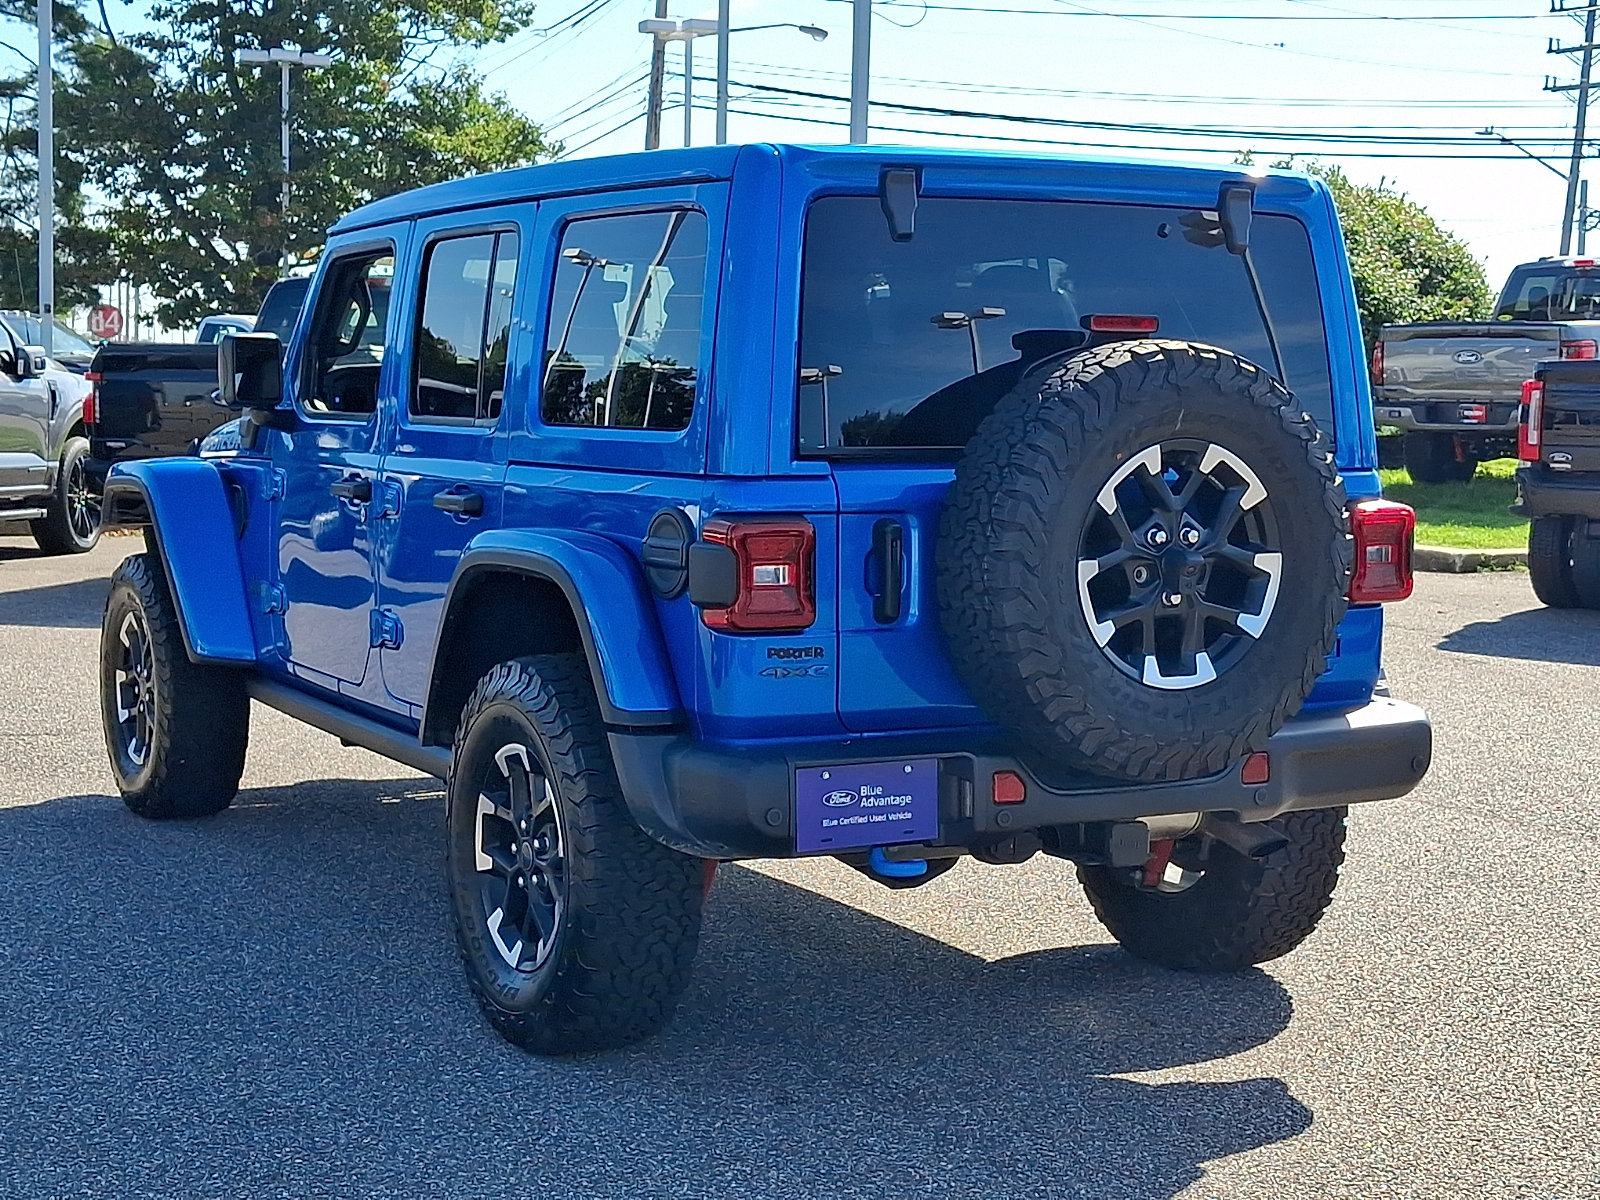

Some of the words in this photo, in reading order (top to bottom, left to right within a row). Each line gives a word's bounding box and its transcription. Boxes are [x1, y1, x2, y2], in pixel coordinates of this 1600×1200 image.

[766, 646, 824, 659] PORTER
[860, 785, 882, 796] Blue
[827, 791, 854, 805] Ford
[860, 795, 912, 807] Advantage
[822, 819, 838, 827] Blue
[839, 815, 868, 825] Certified
[869, 813, 886, 823] Used
[888, 812, 912, 821] Vehicle
